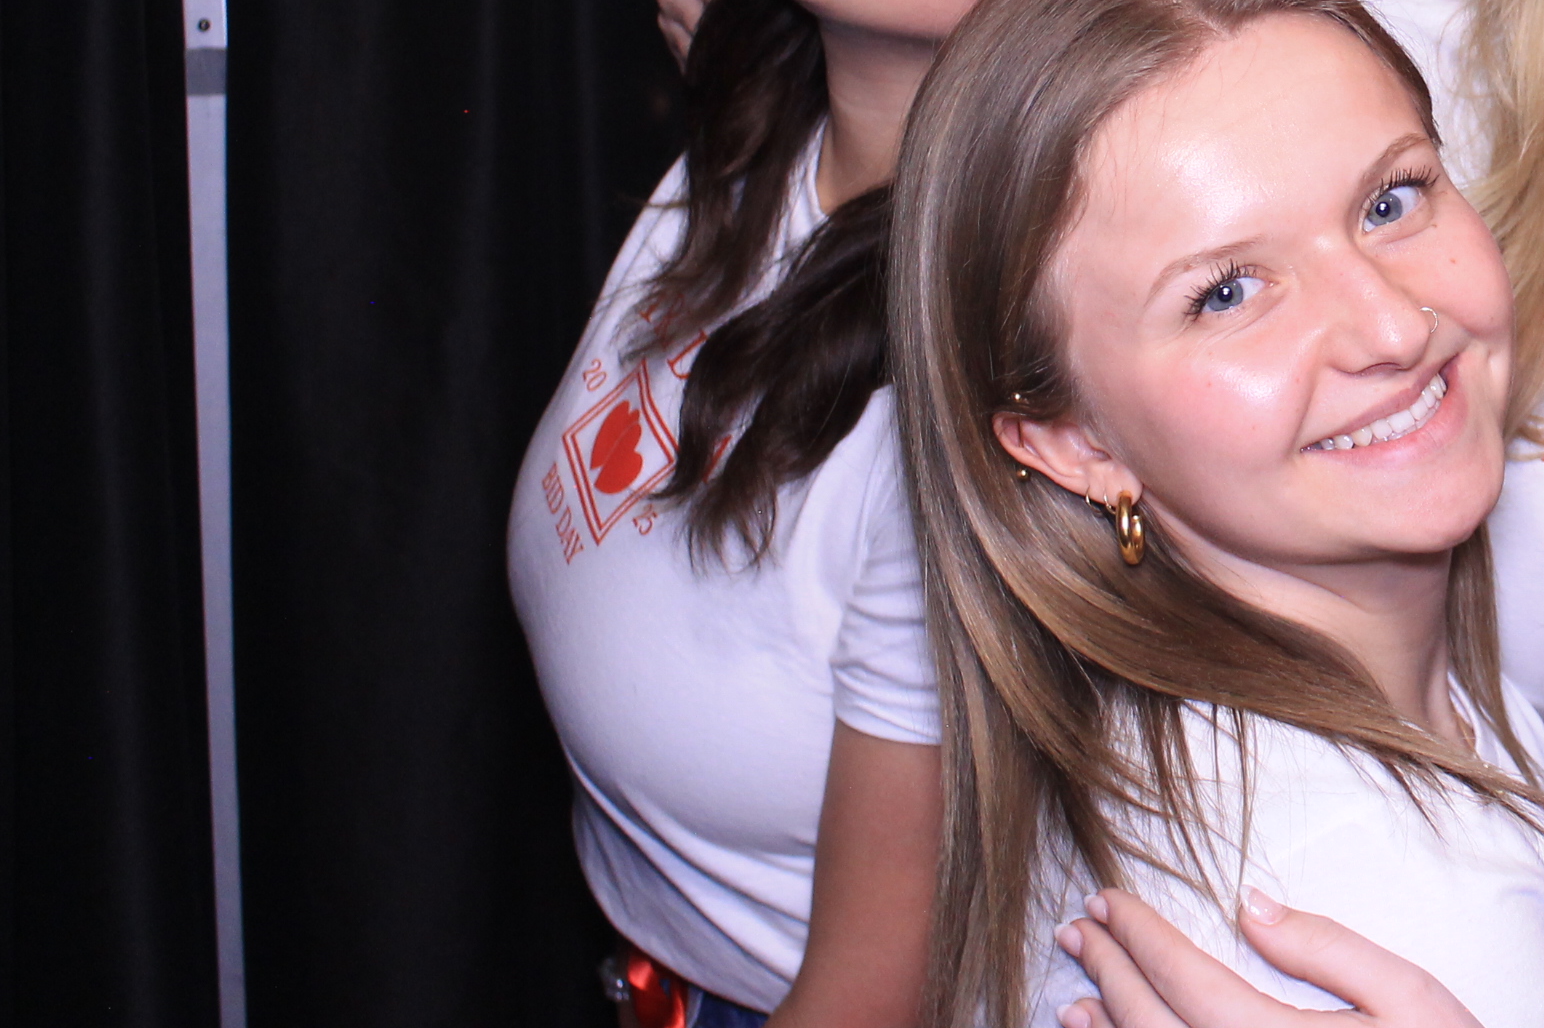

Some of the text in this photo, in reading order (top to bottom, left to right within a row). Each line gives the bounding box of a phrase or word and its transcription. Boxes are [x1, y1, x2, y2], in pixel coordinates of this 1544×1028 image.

[582, 358, 607, 392] 20
[541, 461, 584, 565] BID DAY
